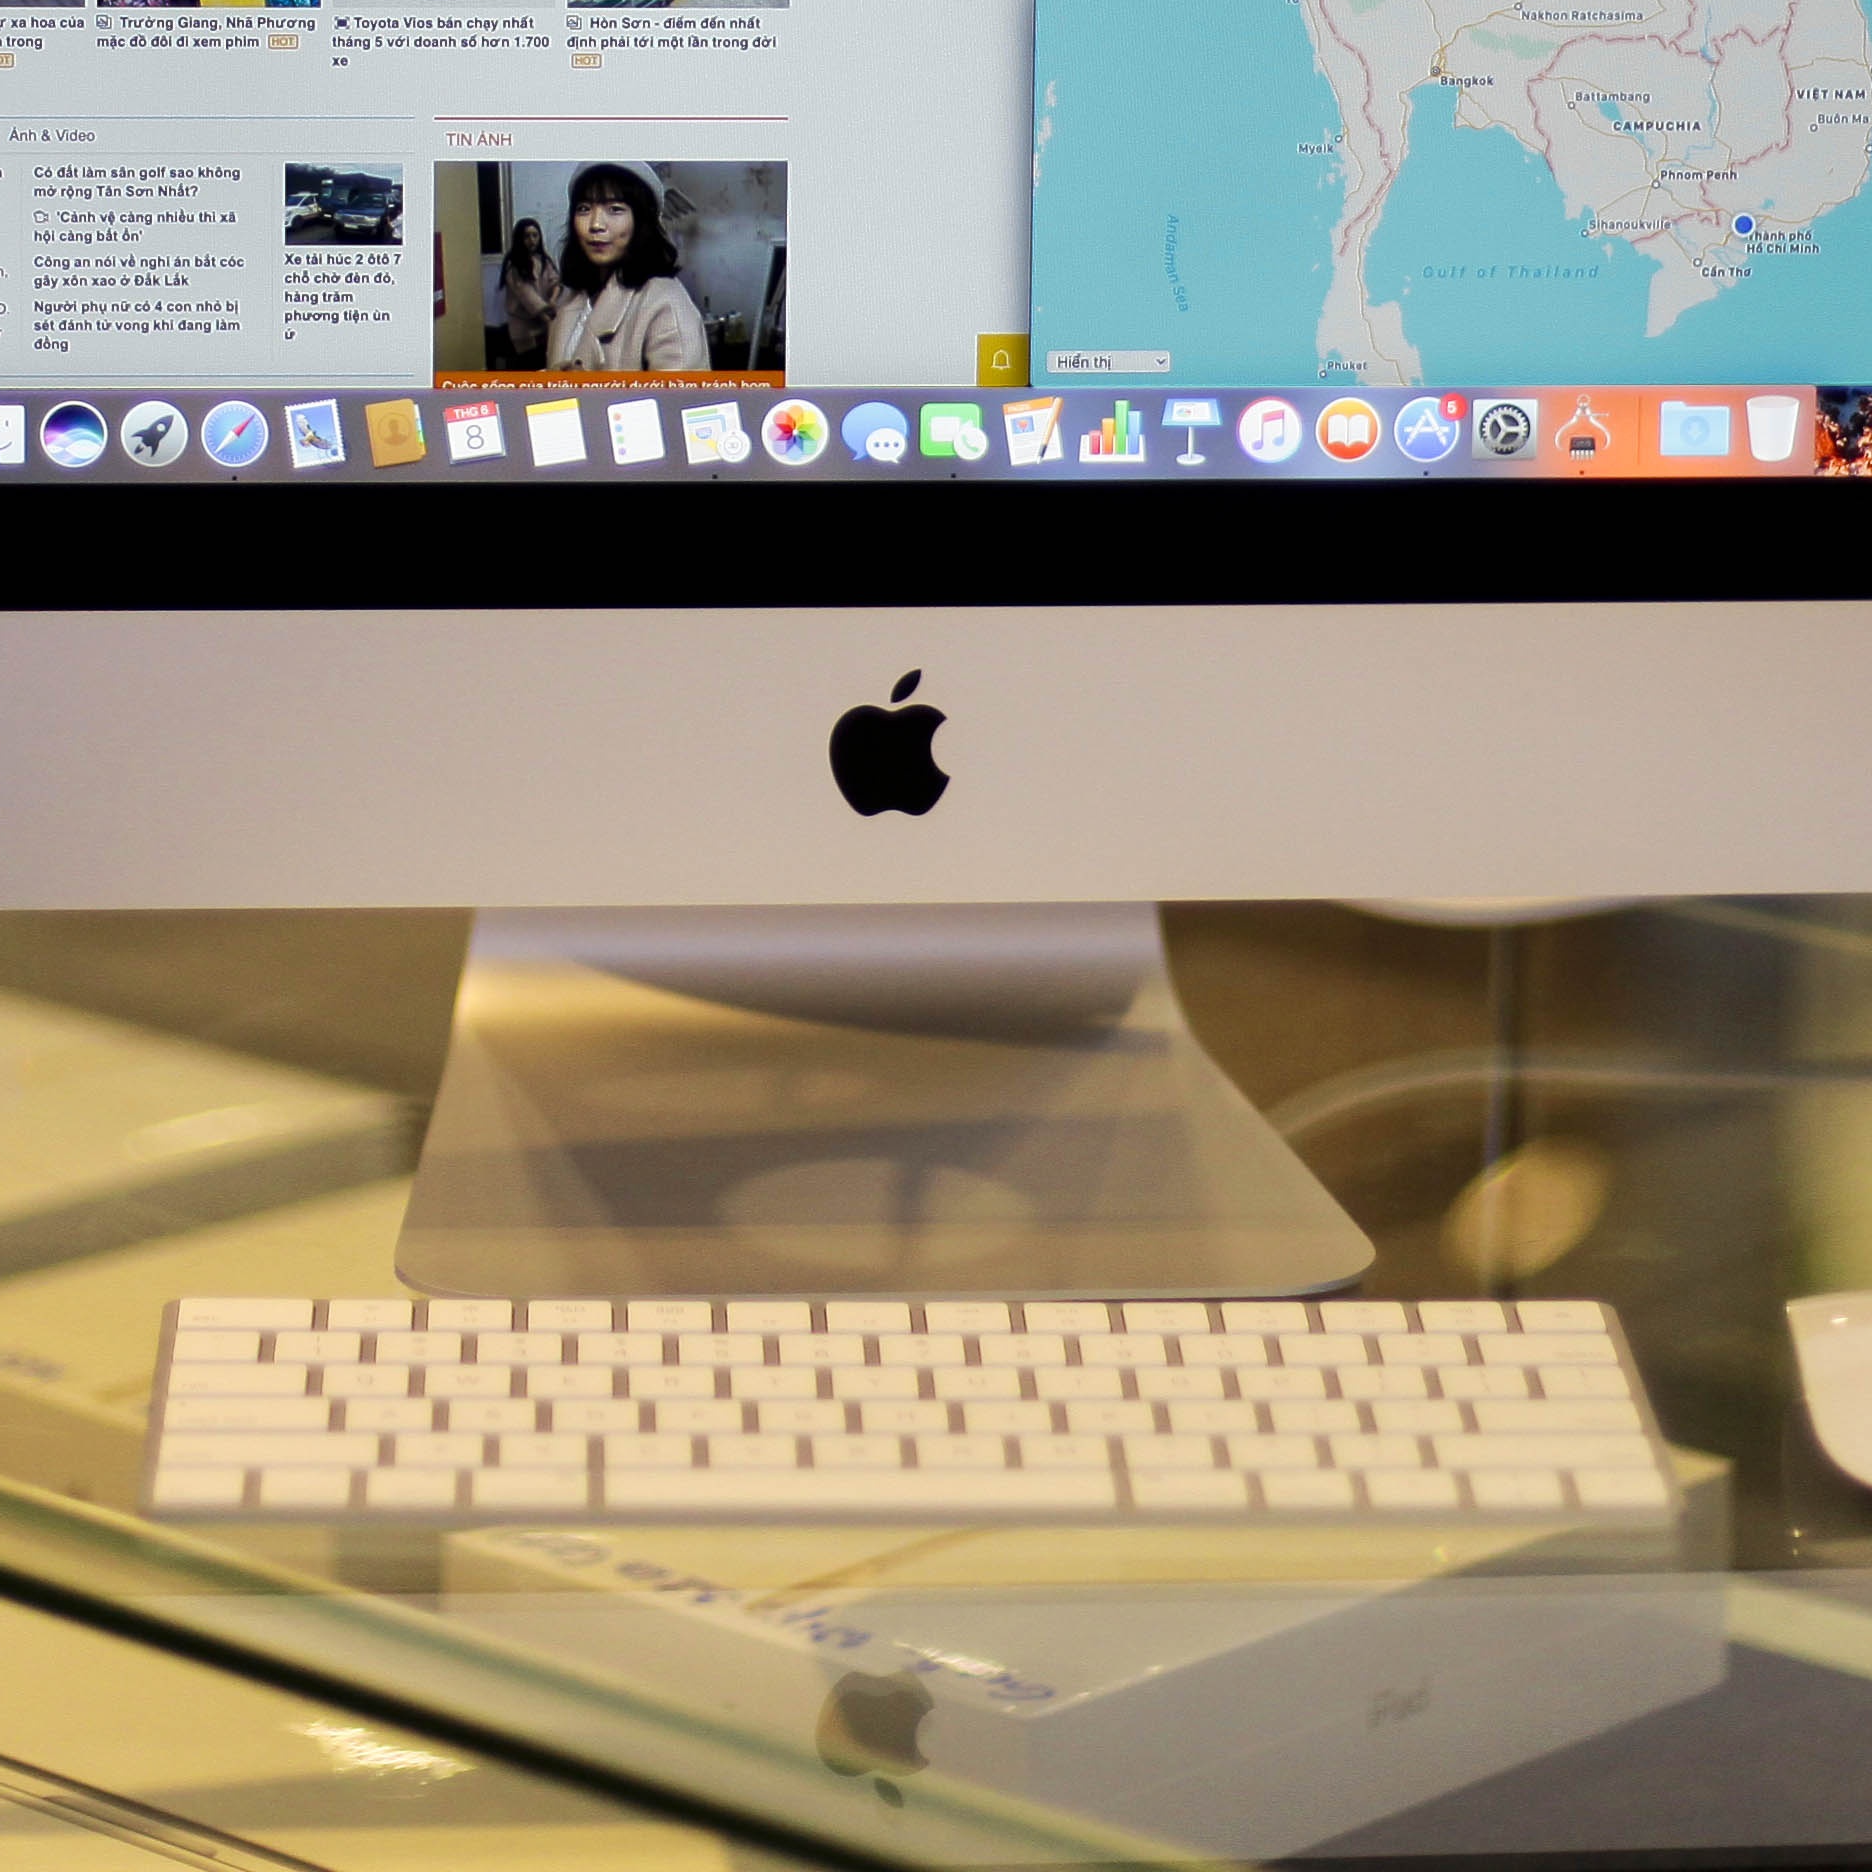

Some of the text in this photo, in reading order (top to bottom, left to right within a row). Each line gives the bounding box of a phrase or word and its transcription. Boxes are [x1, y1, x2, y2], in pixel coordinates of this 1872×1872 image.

[1438, 74, 1493, 88] Bangkok
[1835, 90, 1865, 100] NAM
[1612, 120, 1701, 132] CAMPUCHIA
